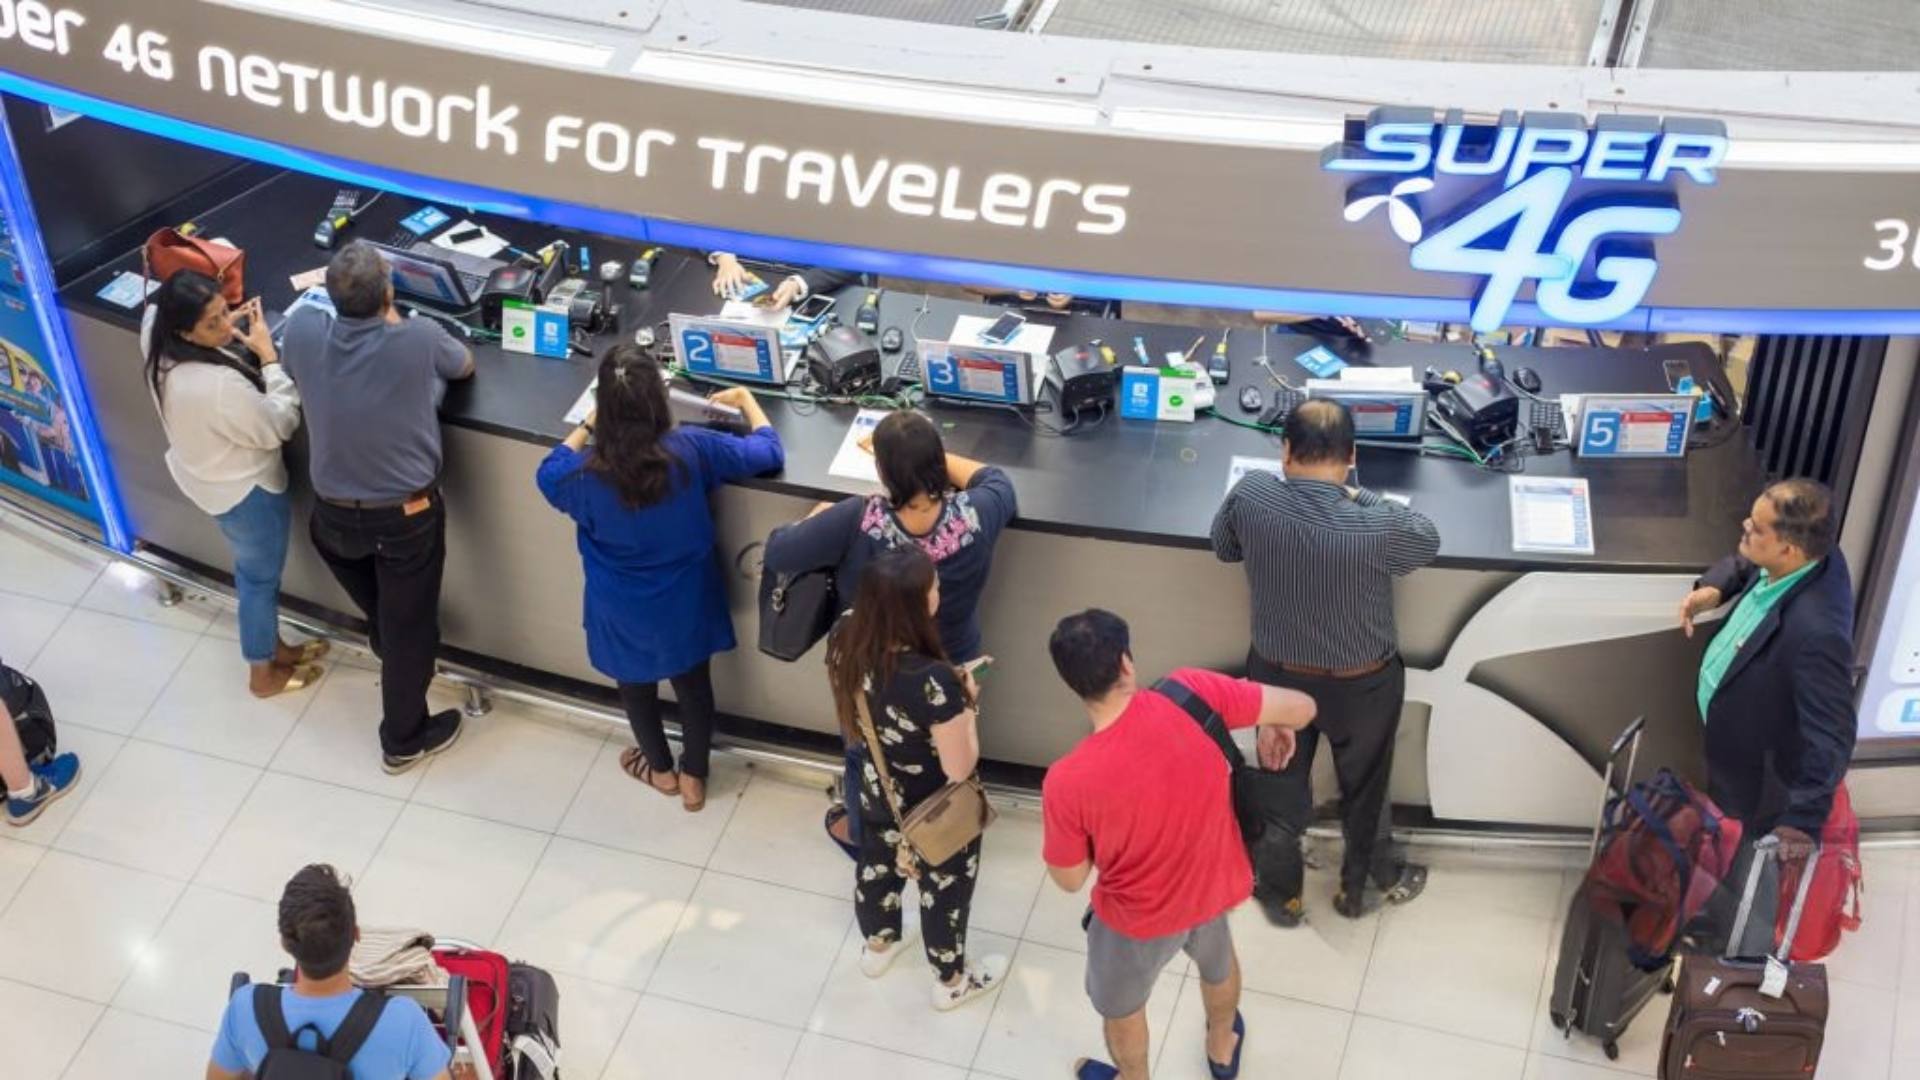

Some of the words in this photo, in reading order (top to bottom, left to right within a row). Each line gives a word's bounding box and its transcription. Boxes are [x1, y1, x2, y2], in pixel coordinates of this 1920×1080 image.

[104, 23, 174, 81] 4G
[1323, 112, 1730, 188] SUPER
[1410, 166, 1682, 333] 4G
[1863, 218, 1920, 271] 3
[687, 334, 712, 363] 2
[932, 361, 954, 385] 3
[1588, 417, 1616, 447] 5
